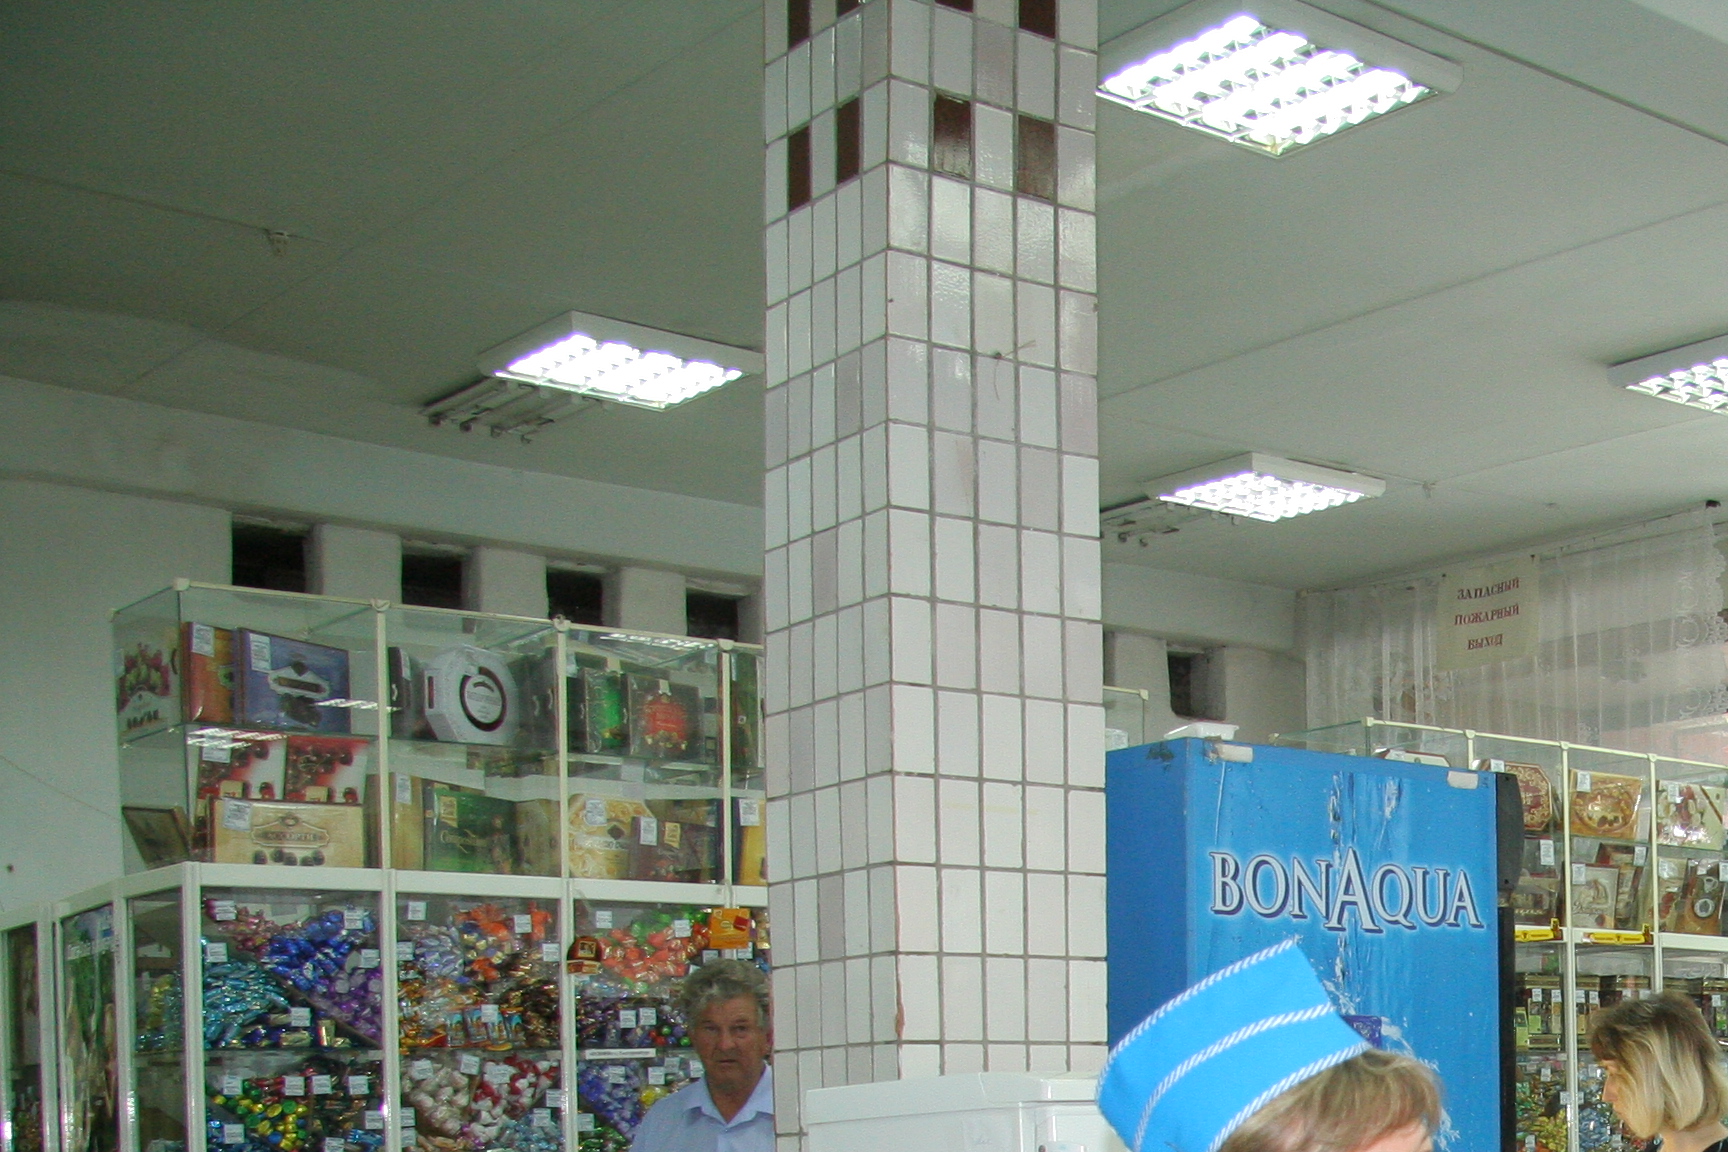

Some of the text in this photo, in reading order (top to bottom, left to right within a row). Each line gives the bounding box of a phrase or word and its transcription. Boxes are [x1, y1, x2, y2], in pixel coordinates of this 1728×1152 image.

[1457, 577, 1520, 600] ЗАПАСНЫЙ
[1454, 603, 1520, 626] ПОЖАРНЫЙ
[1467, 634, 1503, 650] ВЫХОД
